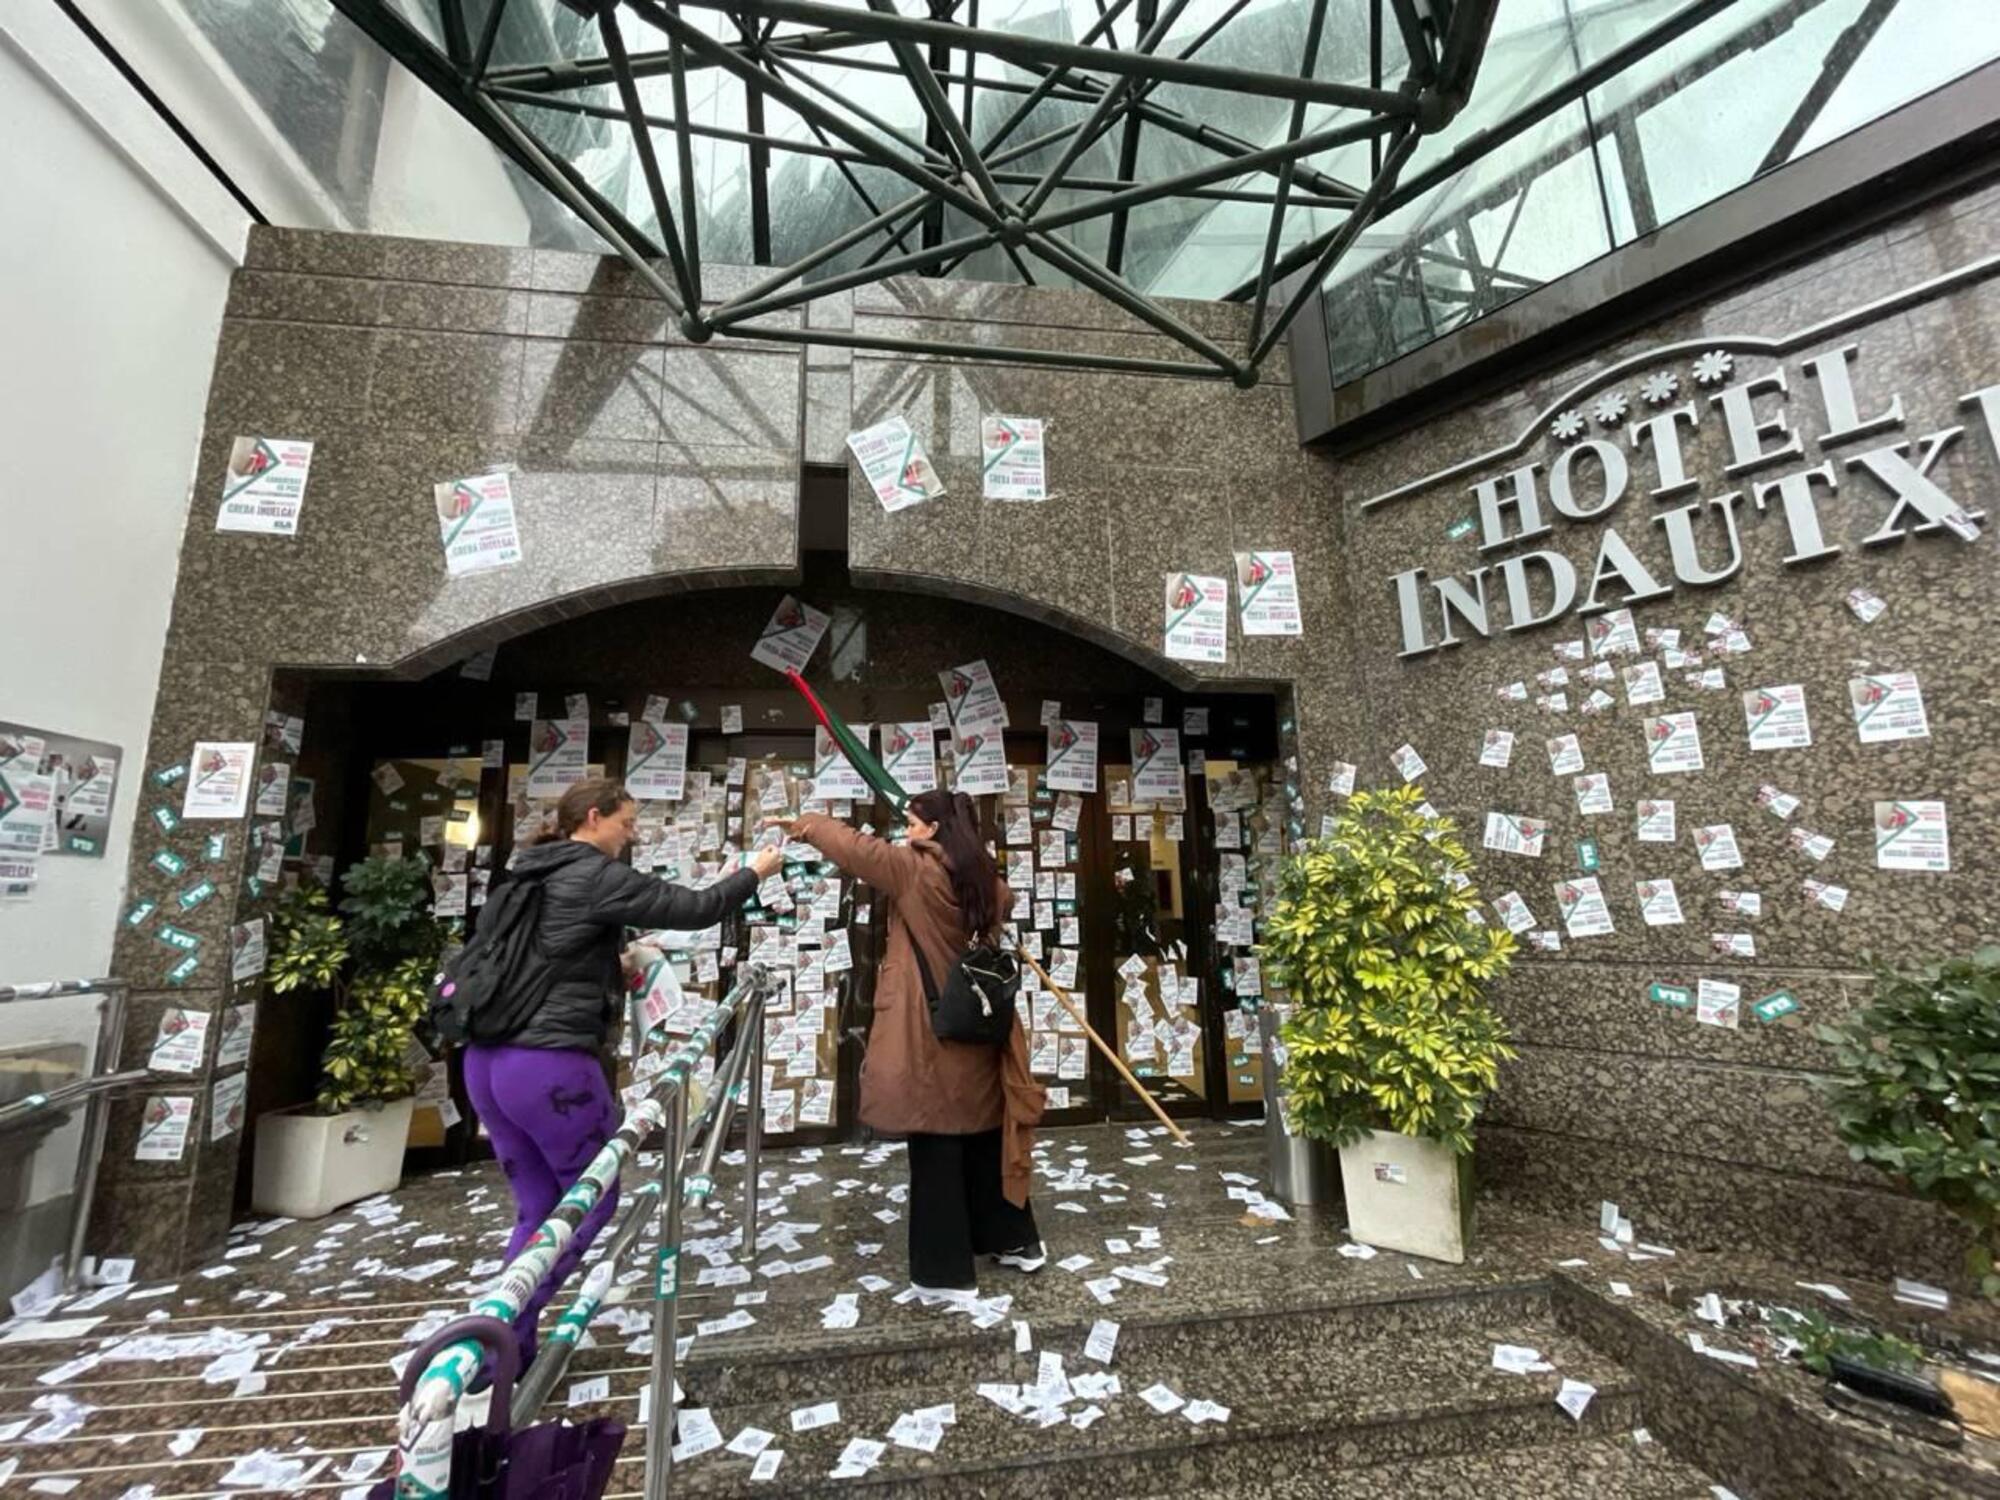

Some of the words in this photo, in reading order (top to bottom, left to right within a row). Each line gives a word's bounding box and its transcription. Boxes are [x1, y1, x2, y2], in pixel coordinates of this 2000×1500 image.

[1469, 343, 1905, 552] HOTEL
[1389, 385, 2000, 657] INDAUTX
[159, 764, 186, 783] ELA
[155, 807, 175, 831] ELA
[72, 837, 94, 851] ELA
[155, 853, 180, 873] ELA
[187, 884, 210, 903] ELA
[129, 903, 154, 924] ELA
[173, 957, 199, 979] ELA
[1658, 988, 1687, 1003] ELA
[1760, 996, 1793, 1016] ELA
[660, 1255, 677, 1295] ELA
